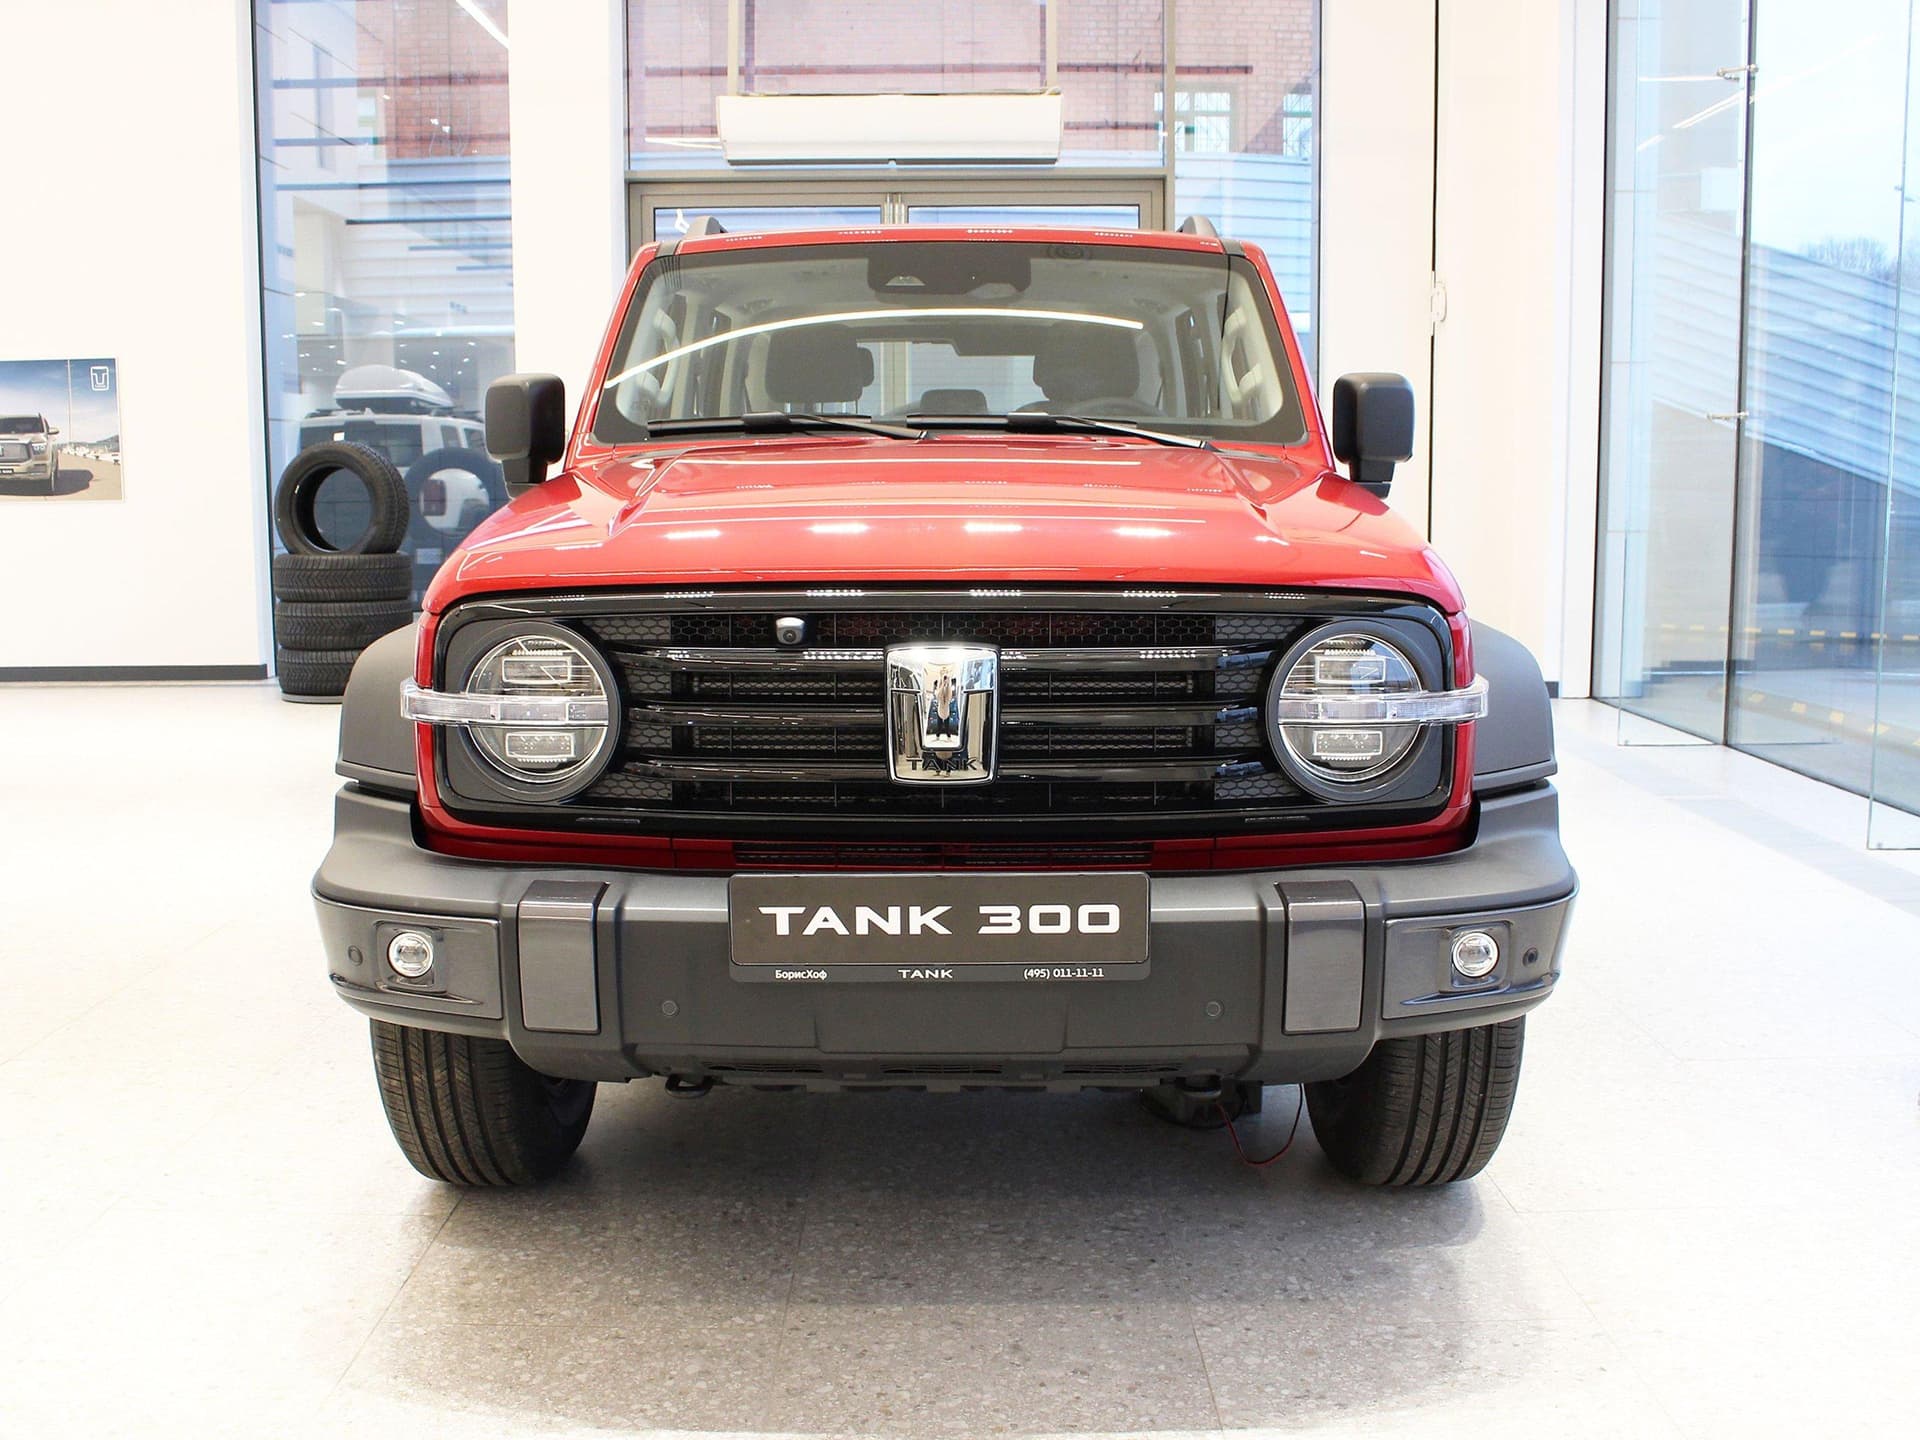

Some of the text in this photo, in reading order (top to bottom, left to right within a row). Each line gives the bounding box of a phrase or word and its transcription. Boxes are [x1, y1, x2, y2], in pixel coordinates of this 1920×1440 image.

[906, 756, 977, 771] TANK
[758, 904, 1120, 935] TANK 300
[775, 969, 828, 981] БорисХоф
[898, 968, 953, 979] TANK
[1023, 968, 1104, 979] (495) 011-11-11
